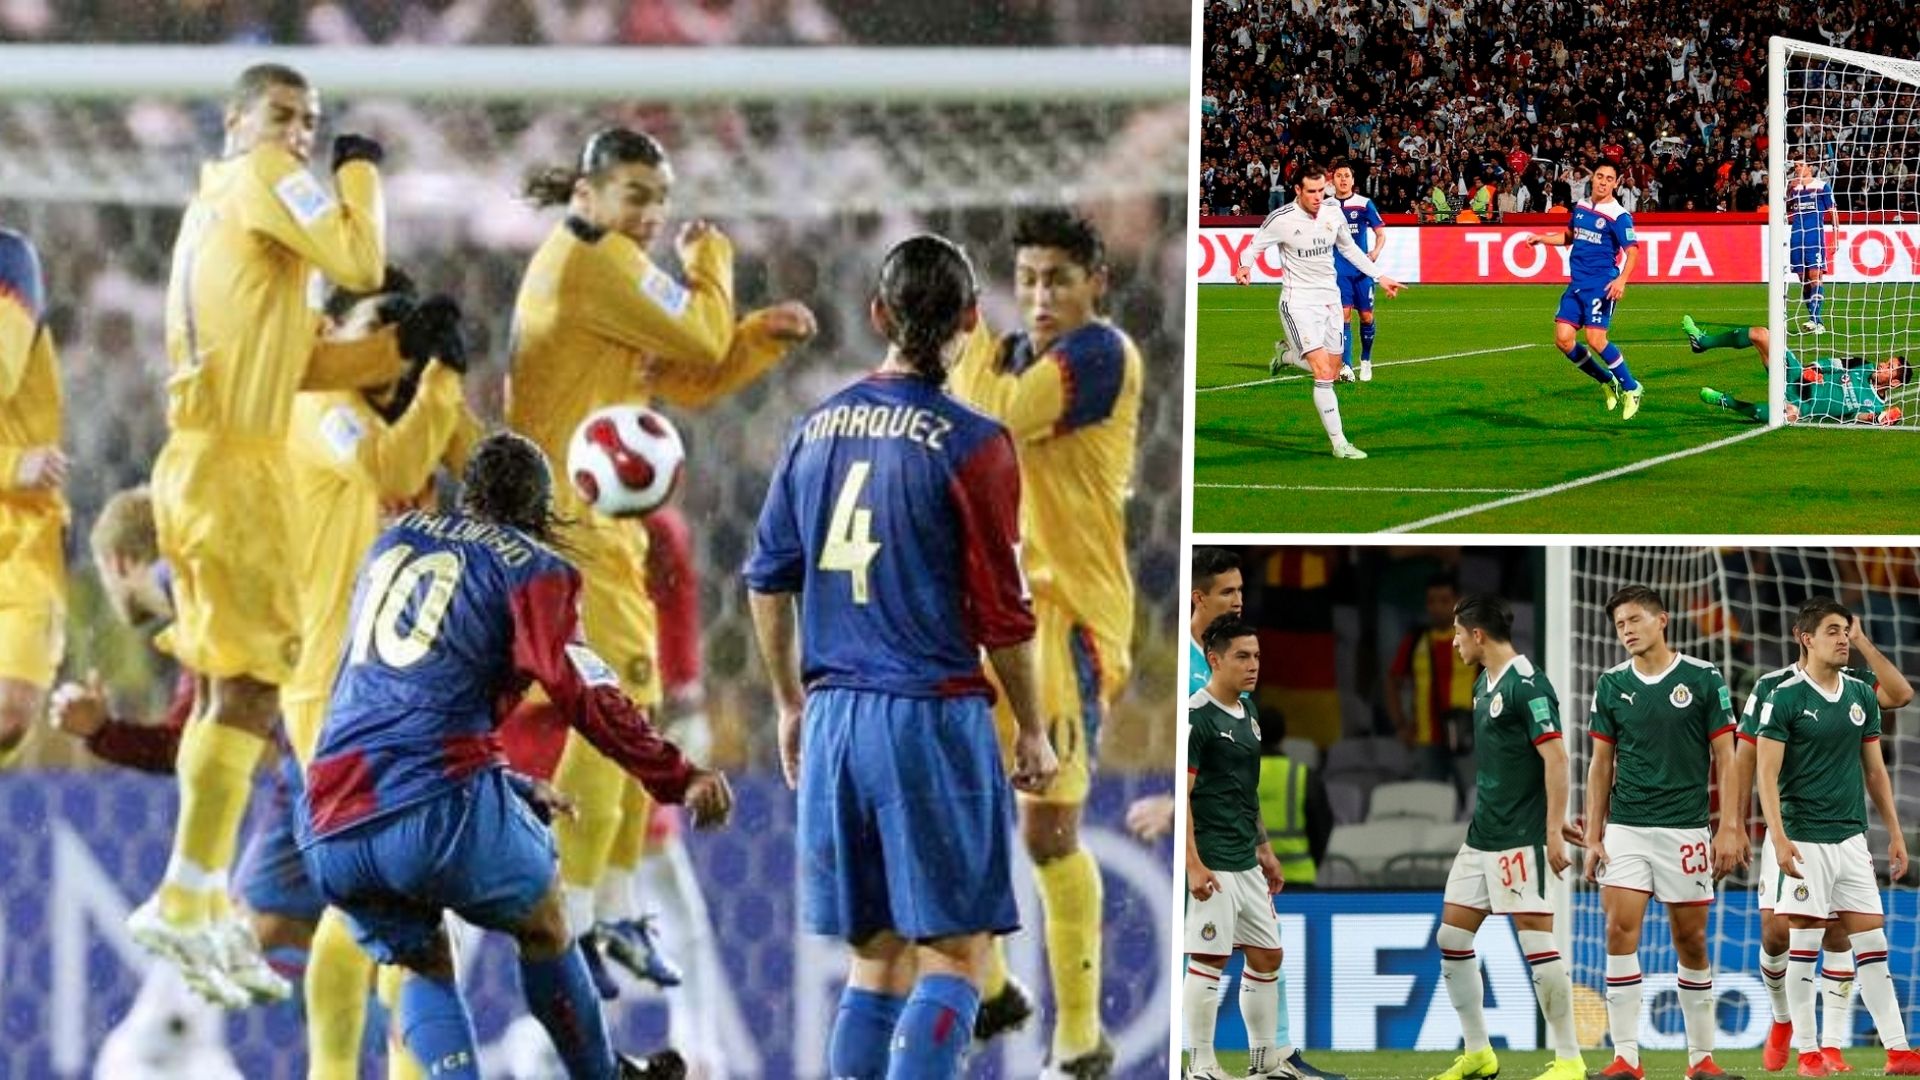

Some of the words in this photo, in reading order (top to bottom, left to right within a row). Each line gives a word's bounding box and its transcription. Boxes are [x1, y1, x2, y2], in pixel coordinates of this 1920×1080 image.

[1465, 231, 1714, 277] TOYTA
[1591, 298, 1603, 316] 2
[803, 406, 953, 450] MARQUEZ
[818, 461, 881, 604] 4
[350, 544, 461, 668] 10
[1499, 851, 1527, 887] 31
[1680, 841, 1708, 875] 23
[1217, 913, 1536, 1050] IFA
